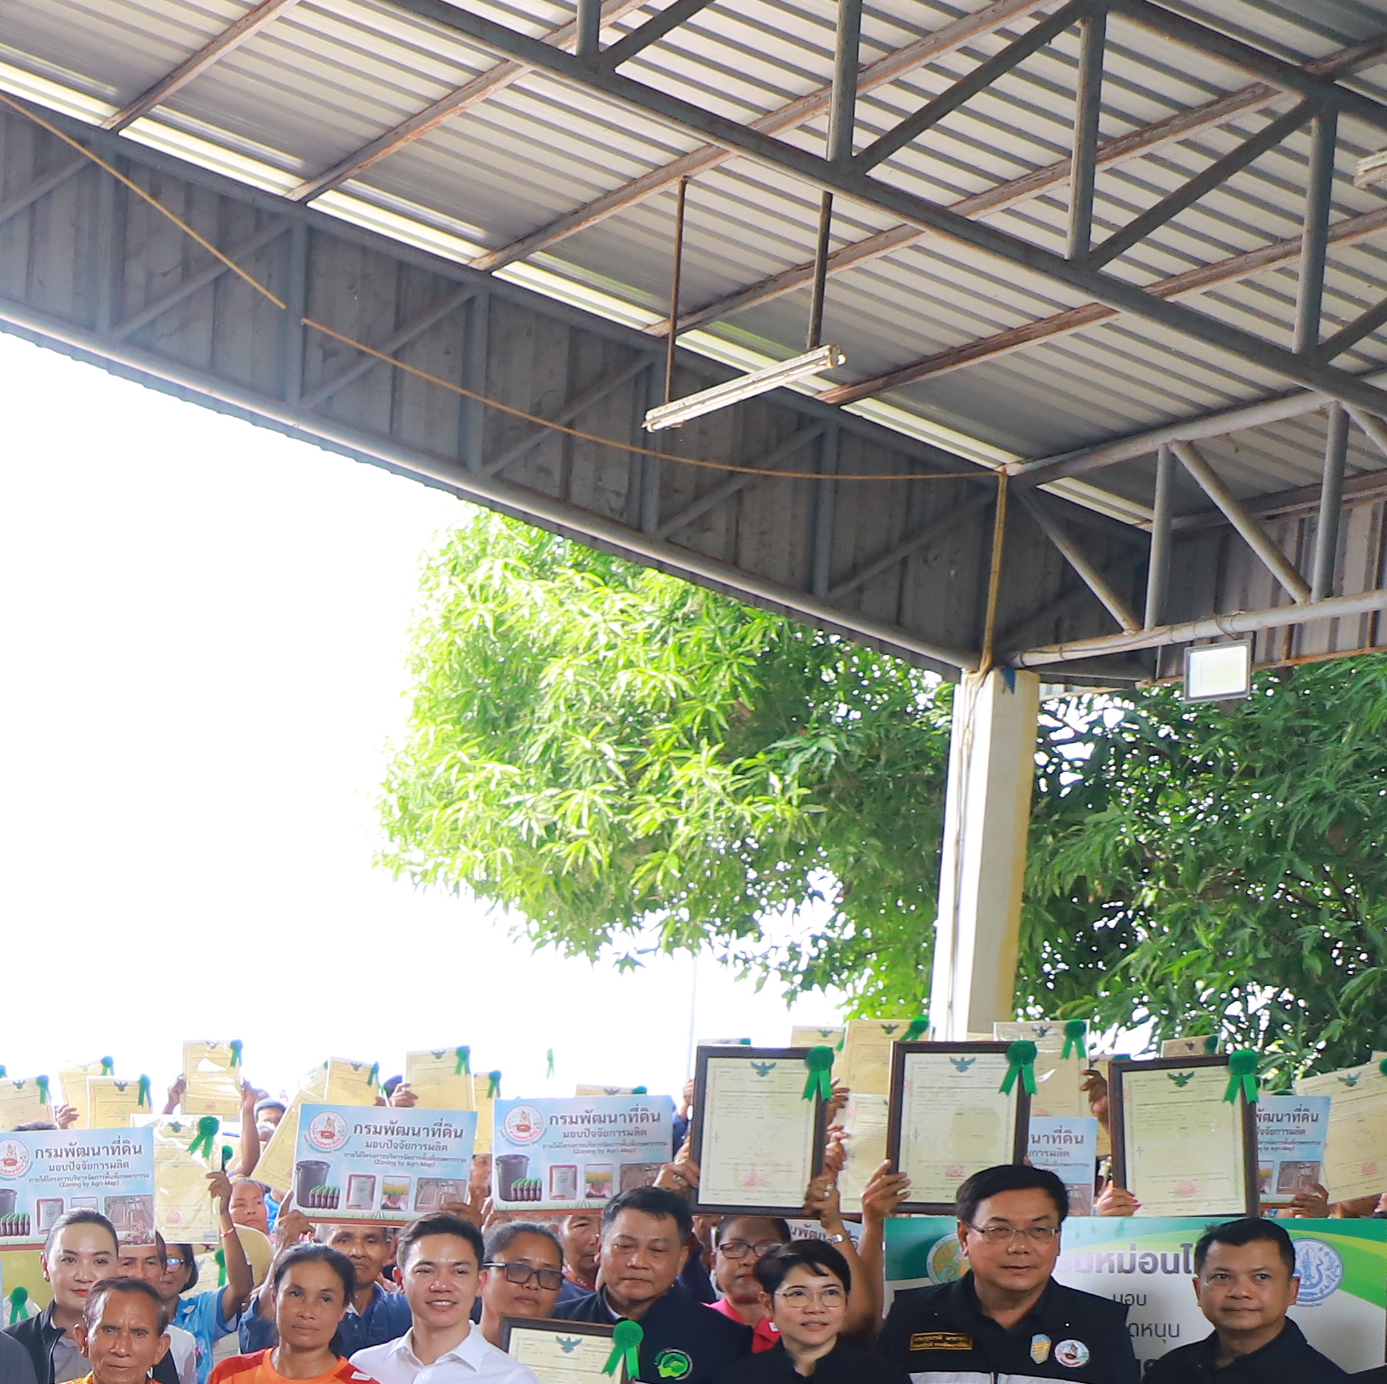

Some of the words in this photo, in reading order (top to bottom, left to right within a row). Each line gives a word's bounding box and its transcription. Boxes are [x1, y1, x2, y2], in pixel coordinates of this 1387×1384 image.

[549, 1103, 661, 1126] กรมพัฒนาที่ดิน
[353, 1117, 464, 1139] กรมพัฒนาที่ดิน
[562, 1126, 647, 1139] มอบปัจจัยการผลิต
[34, 1135, 142, 1159] กรมพัฒนาที่ดิน
[365, 1138, 448, 1152] มอบปัจจัยการผลิต
[48, 1158, 130, 1172] มอบปัจจัยการผลิต
[1056, 1243, 1196, 1274] รมหม่อนไ
